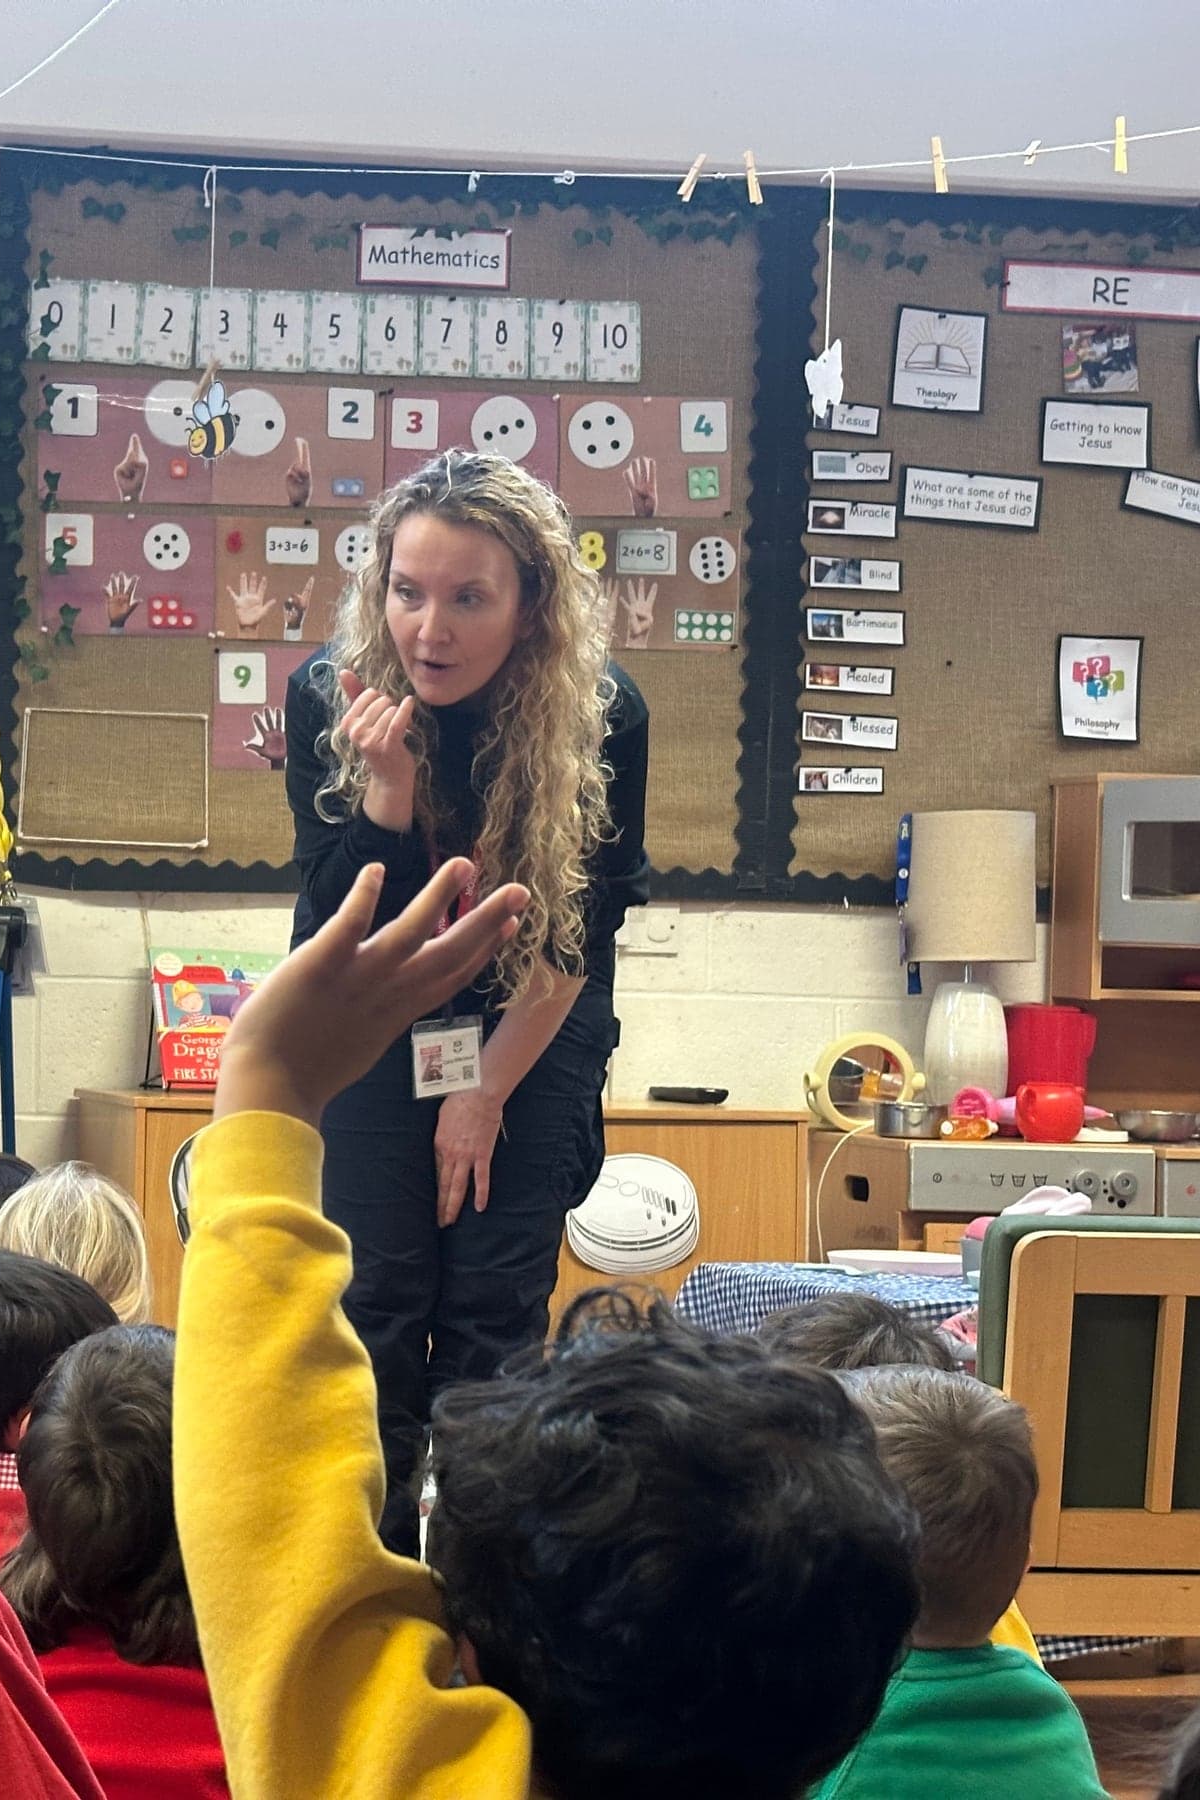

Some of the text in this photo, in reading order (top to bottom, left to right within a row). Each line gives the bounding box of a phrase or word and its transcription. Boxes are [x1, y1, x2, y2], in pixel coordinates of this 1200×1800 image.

[368, 245, 500, 269] Mathematics
[1092, 276, 1131, 305] RE
[159, 307, 174, 333] 2
[218, 309, 230, 335] 3
[273, 312, 288, 338] 4
[328, 313, 341, 339] 5
[384, 316, 396, 341] 6
[440, 318, 453, 343] 7
[495, 319, 508, 345] 8
[552, 321, 563, 347] 9
[603, 323, 627, 349] 10
[915, 387, 958, 401] Theology
[67, 397, 79, 419] 1
[341, 400, 359, 423] 2
[405, 411, 424, 434] 3
[693, 414, 714, 437] 4
[838, 413, 871, 428] Jesus
[1050, 418, 1142, 436] Getting to know
[1079, 436, 1113, 450] Jesus
[856, 462, 886, 476] Obey
[913, 480, 1032, 503] What are some of the
[1161, 479, 1179, 491] can
[849, 505, 891, 519] Miracle
[910, 494, 1032, 517] things that Jesus did?
[62, 526, 78, 549] 5
[868, 568, 893, 581] Blind
[233, 664, 252, 688] 9
[846, 670, 885, 685] Healed
[851, 720, 894, 736] Blessed
[1074, 717, 1121, 732] Philosophy
[832, 772, 879, 786] Children
[173, 1068, 198, 1080] FIRE
